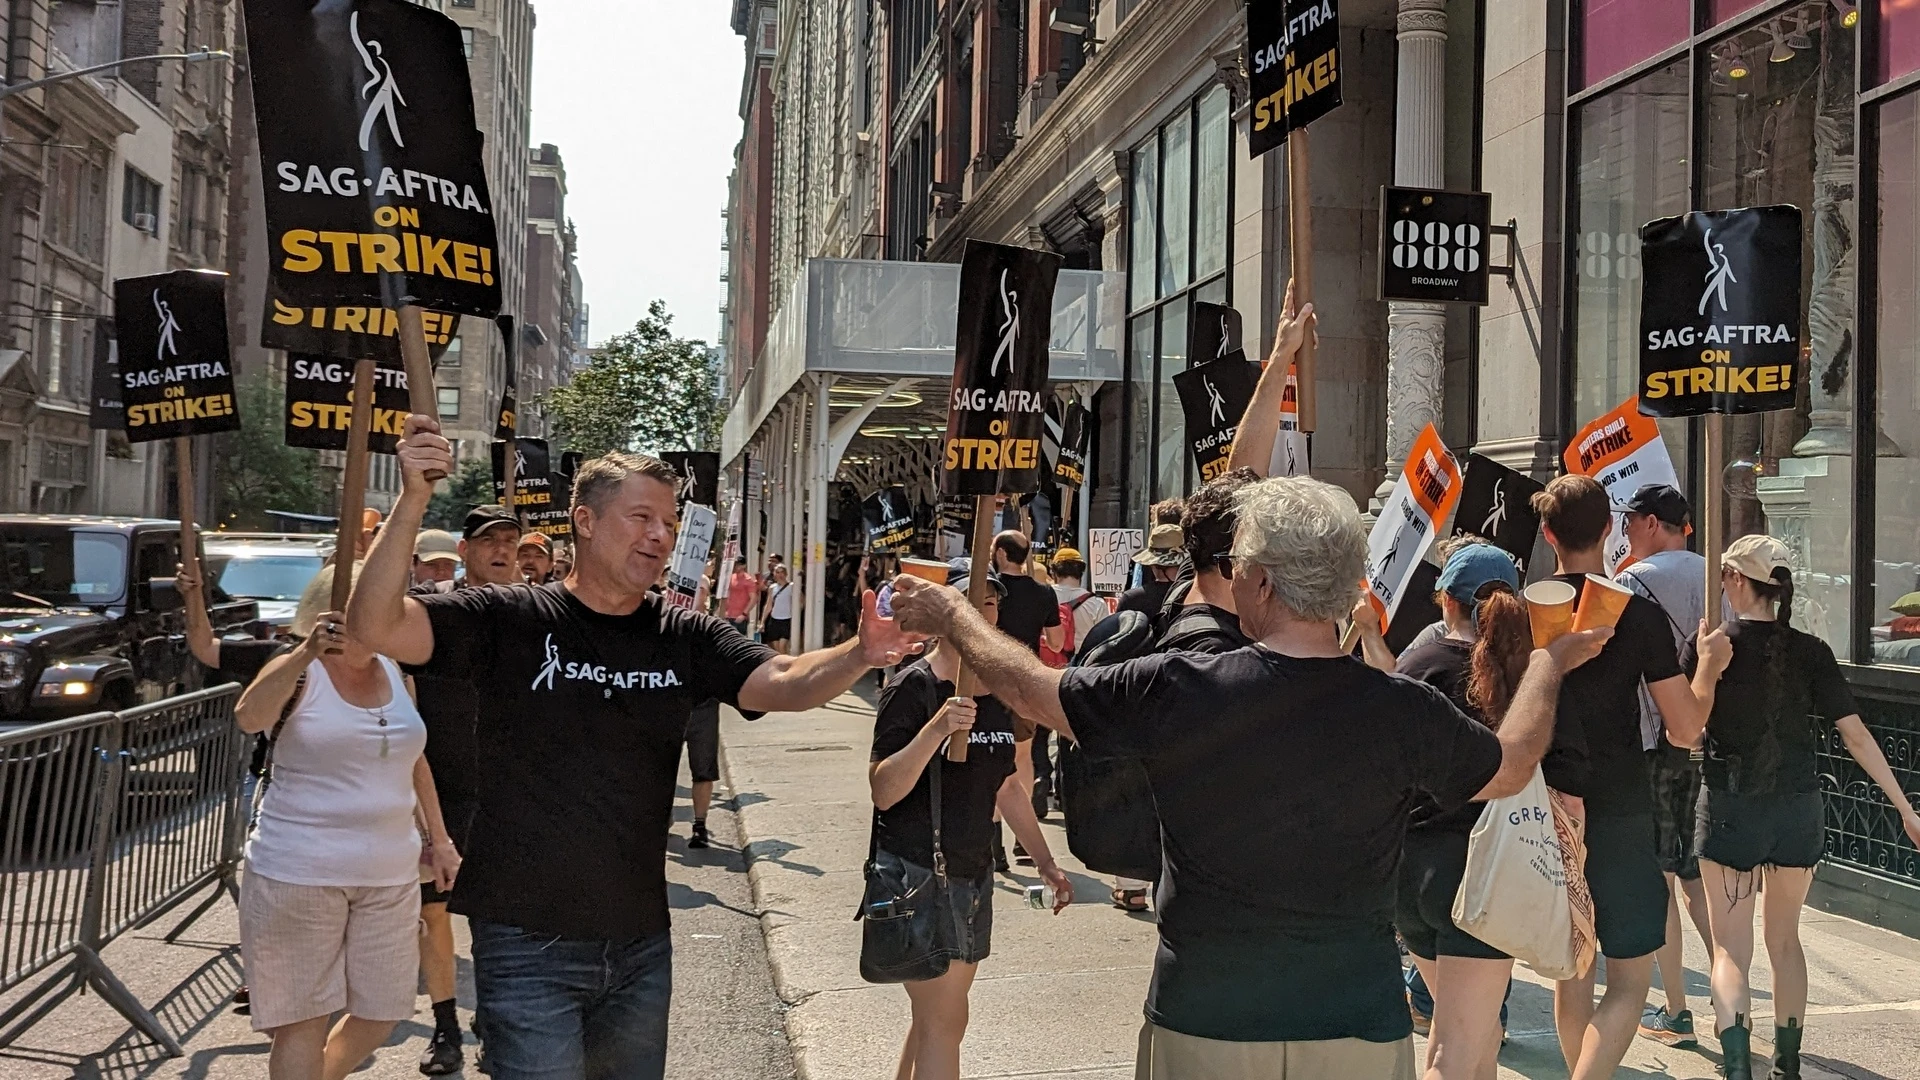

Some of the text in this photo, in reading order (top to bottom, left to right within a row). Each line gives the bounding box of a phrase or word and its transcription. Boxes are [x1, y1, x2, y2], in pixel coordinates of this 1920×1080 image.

[1254, 48, 1337, 131] STIKE!
[374, 206, 420, 228] ON
[1392, 220, 1480, 272] 888
[281, 229, 494, 286] STRIKE!
[1411, 276, 1459, 287] BROADWAY
[1700, 350, 1731, 363] ON
[164, 386, 185, 398] ON
[1646, 365, 1792, 398] STRIKE!
[127, 394, 233, 427] STRIKE!
[290, 401, 414, 436] STRKE
[989, 420, 1009, 435] ON
[1604, 416, 1626, 439] GUILD
[1580, 425, 1634, 472] ON STRIKE
[1618, 461, 1640, 479] WITH
[498, 493, 551, 507] SRIKE!
[1419, 471, 1447, 510] STRIKE
[872, 527, 914, 549] STRIKE!
[1412, 516, 1428, 538] WITH
[1109, 530, 1143, 552] EATS
[1095, 583, 1123, 591] WRITERS
[1509, 806, 1547, 825] GREY
